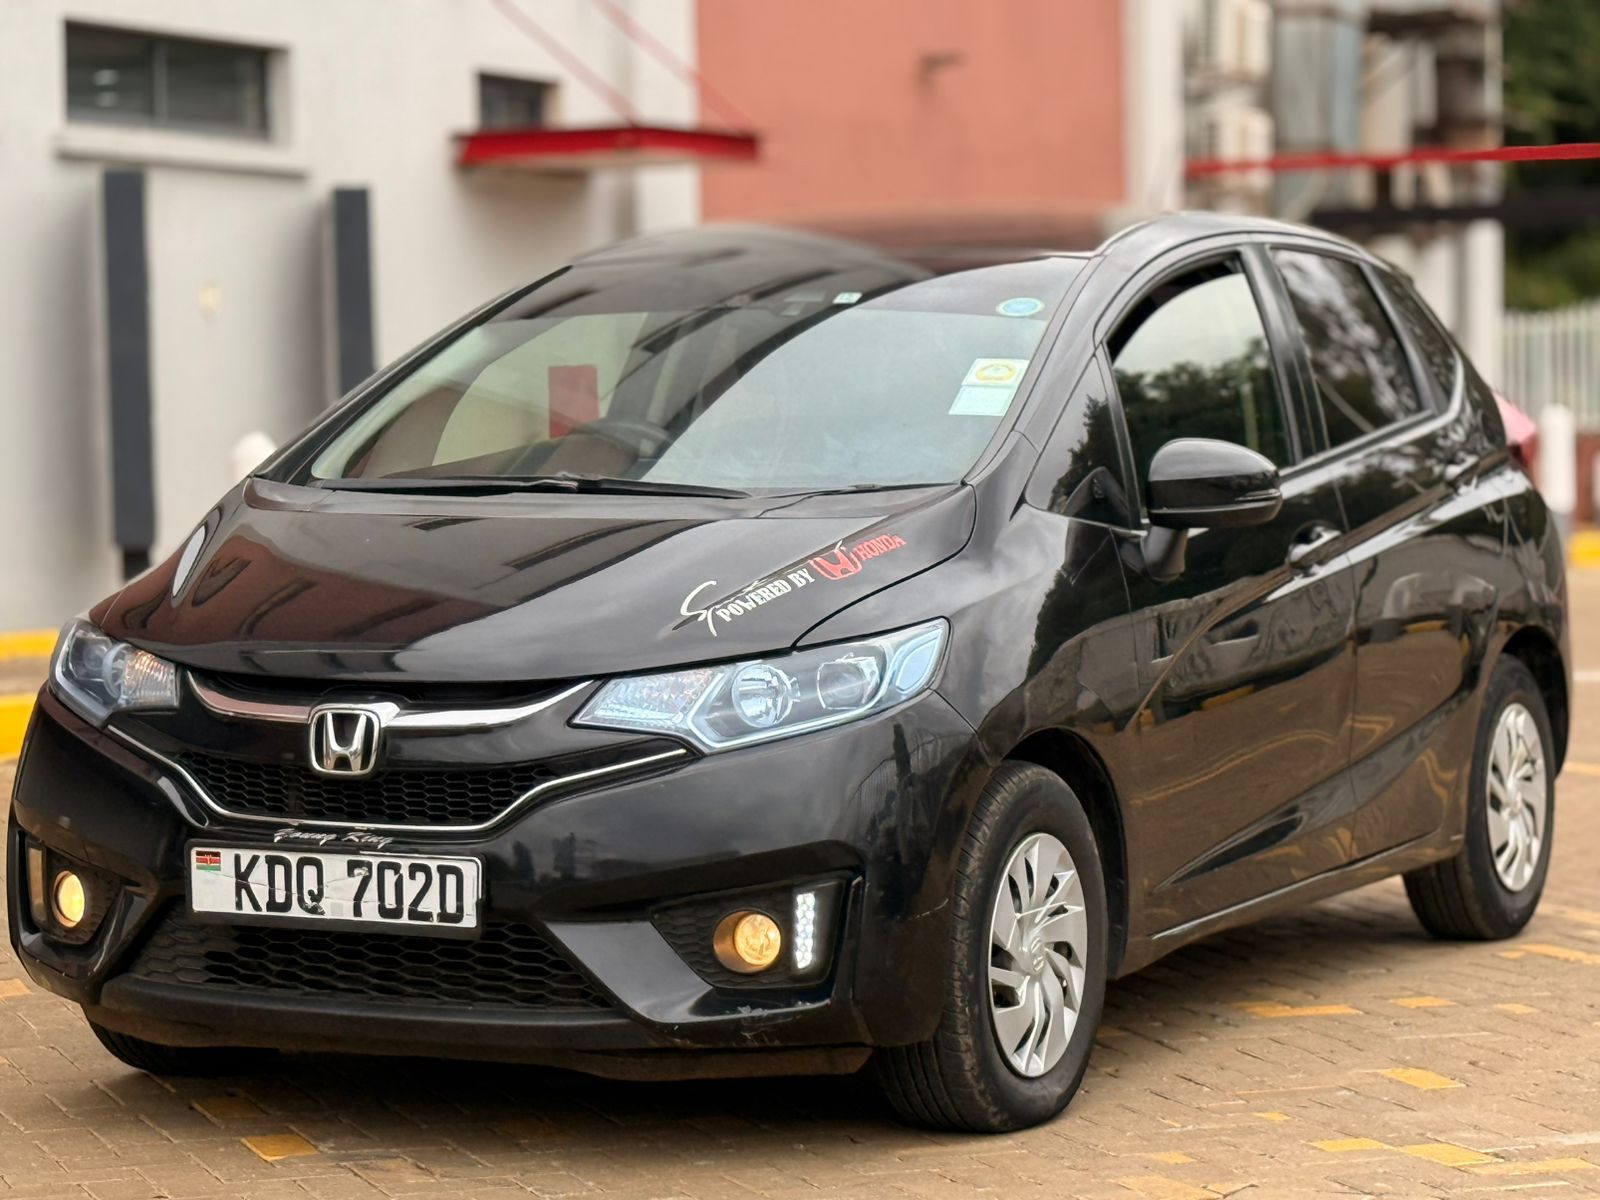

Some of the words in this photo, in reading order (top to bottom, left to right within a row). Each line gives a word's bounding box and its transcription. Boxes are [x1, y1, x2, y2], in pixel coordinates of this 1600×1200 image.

[715, 579, 792, 622] POWERED
[787, 568, 816, 588] BY
[853, 534, 907, 560] HONDA
[234, 853, 325, 916] KDQ
[347, 859, 464, 924] 702D
